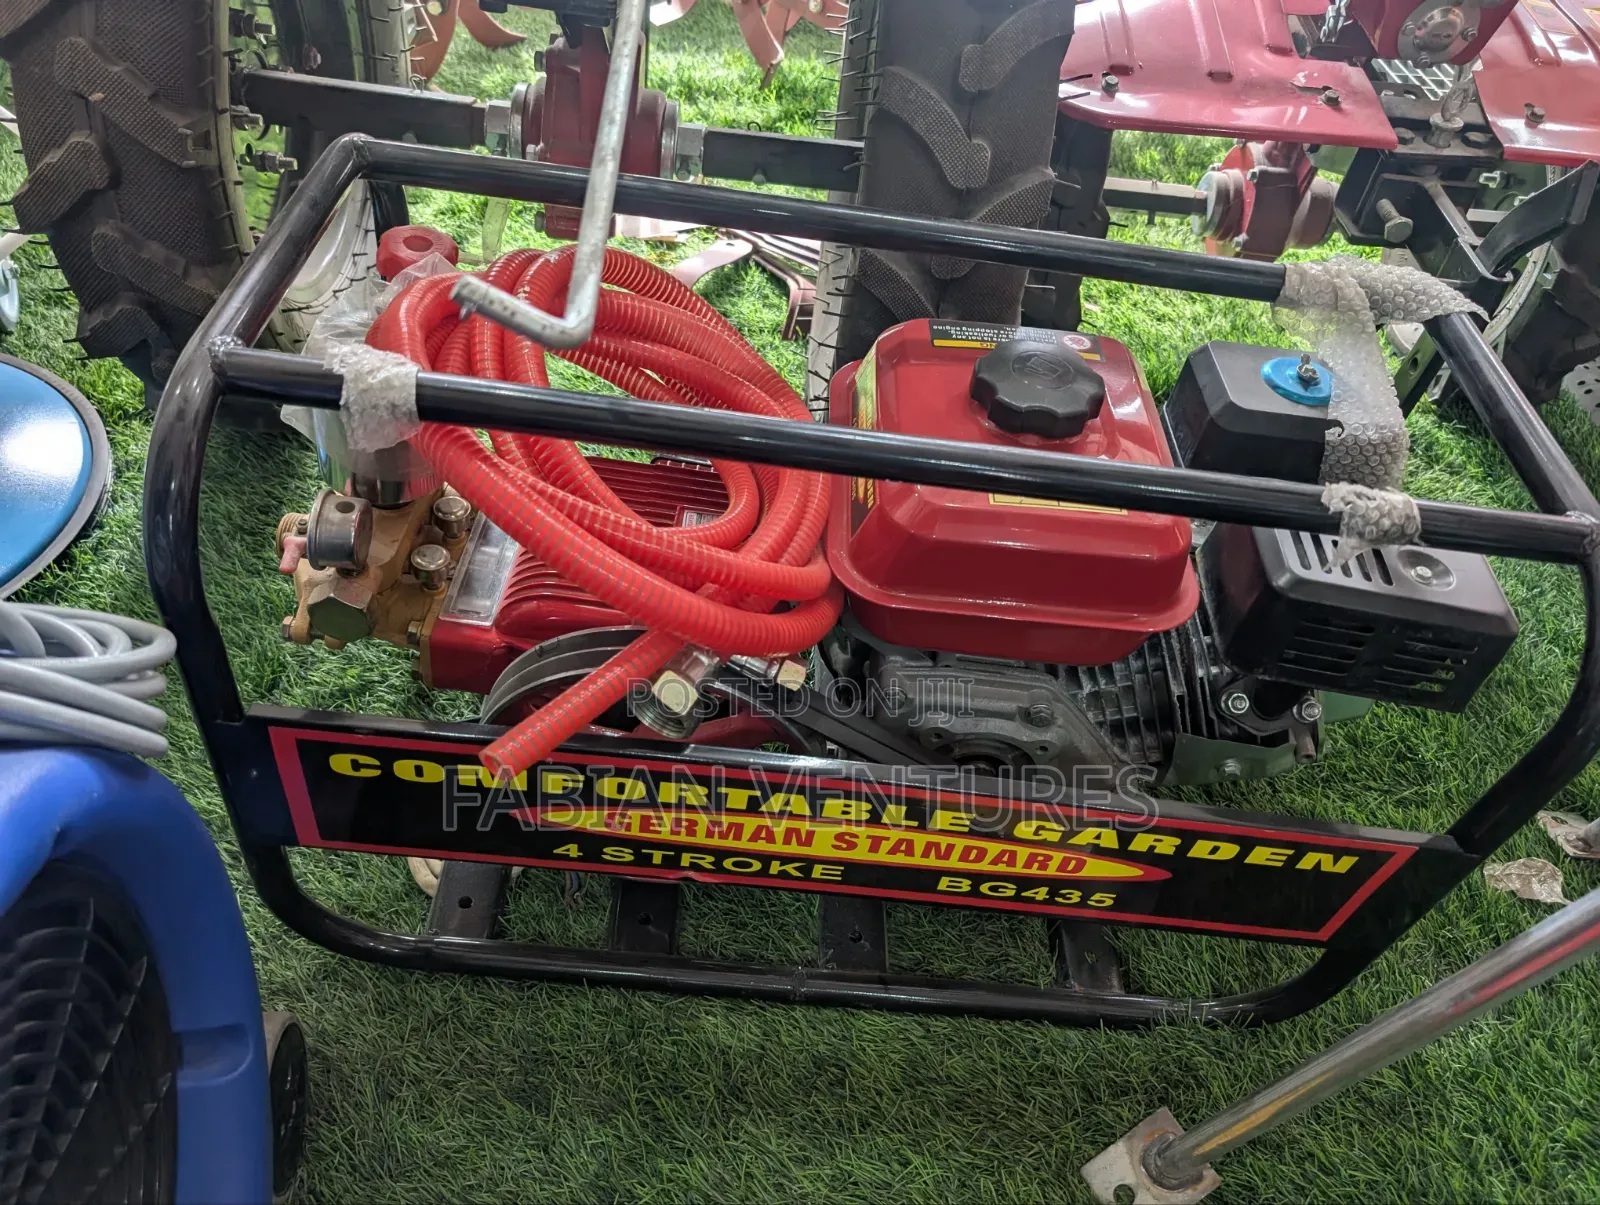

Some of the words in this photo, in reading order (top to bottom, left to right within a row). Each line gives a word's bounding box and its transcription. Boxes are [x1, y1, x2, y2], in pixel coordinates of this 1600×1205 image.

[328, 753, 976, 833] COMFORTABLE
[1013, 819, 1360, 874] GARDEN
[603, 810, 817, 848] GERMAN
[831, 831, 1088, 875] STANDARD
[552, 843, 583, 858] 4
[600, 846, 845, 881] STROKE
[936, 875, 1118, 908] BG435
